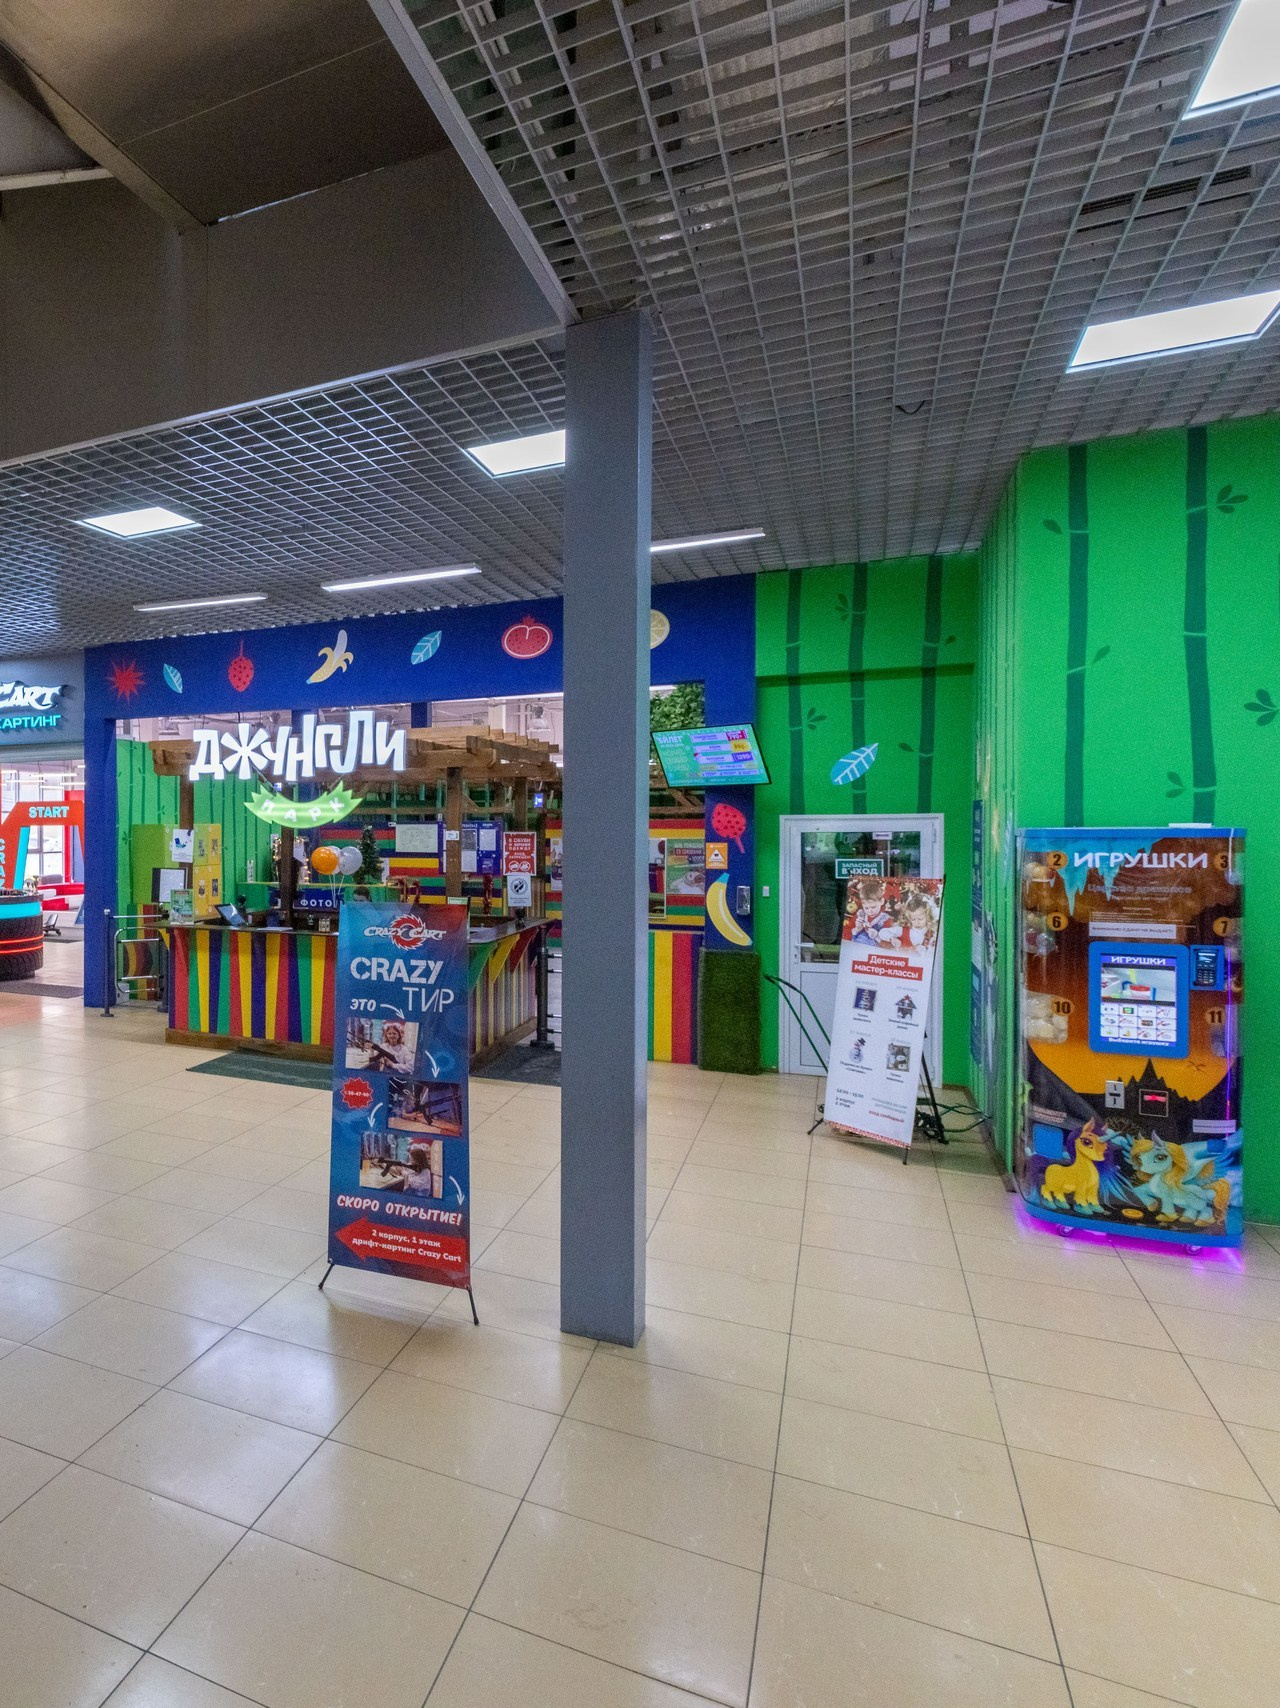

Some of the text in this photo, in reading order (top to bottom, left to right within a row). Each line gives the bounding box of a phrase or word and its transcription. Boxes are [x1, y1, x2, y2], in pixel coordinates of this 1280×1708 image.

[189, 710, 407, 782] ДЖУНГЛИ
[28, 806, 69, 819] START
[261, 797, 345, 823] ПАРК
[1052, 854, 1062, 866] 2
[1073, 852, 1209, 869] ИГРУШКИ
[1220, 855, 1229, 869] 3
[841, 868, 879, 876] ВЫХОД
[300, 899, 333, 907] ФОТО
[1052, 916, 1061, 929] 6
[1221, 921, 1228, 934] 7
[364, 926, 447, 940] CRAZY CART
[869, 956, 906, 967] Детские
[1111, 956, 1166, 966] ИГРУШКИ
[350, 957, 444, 984] CRAZY
[854, 964, 919, 979] мастер-классы
[350, 999, 377, 1011] ЭТО
[402, 987, 455, 1013] ТИР
[1055, 1001, 1071, 1015] 10
[1209, 1011, 1223, 1023] 11
[336, 1194, 463, 1226] СКОРО ОТКРЫТИЕ!
[378, 1232, 410, 1243] корпус,
[419, 1239, 441, 1248] этаж
[352, 1238, 462, 1262] дрифт-картинг Crazy Cart
